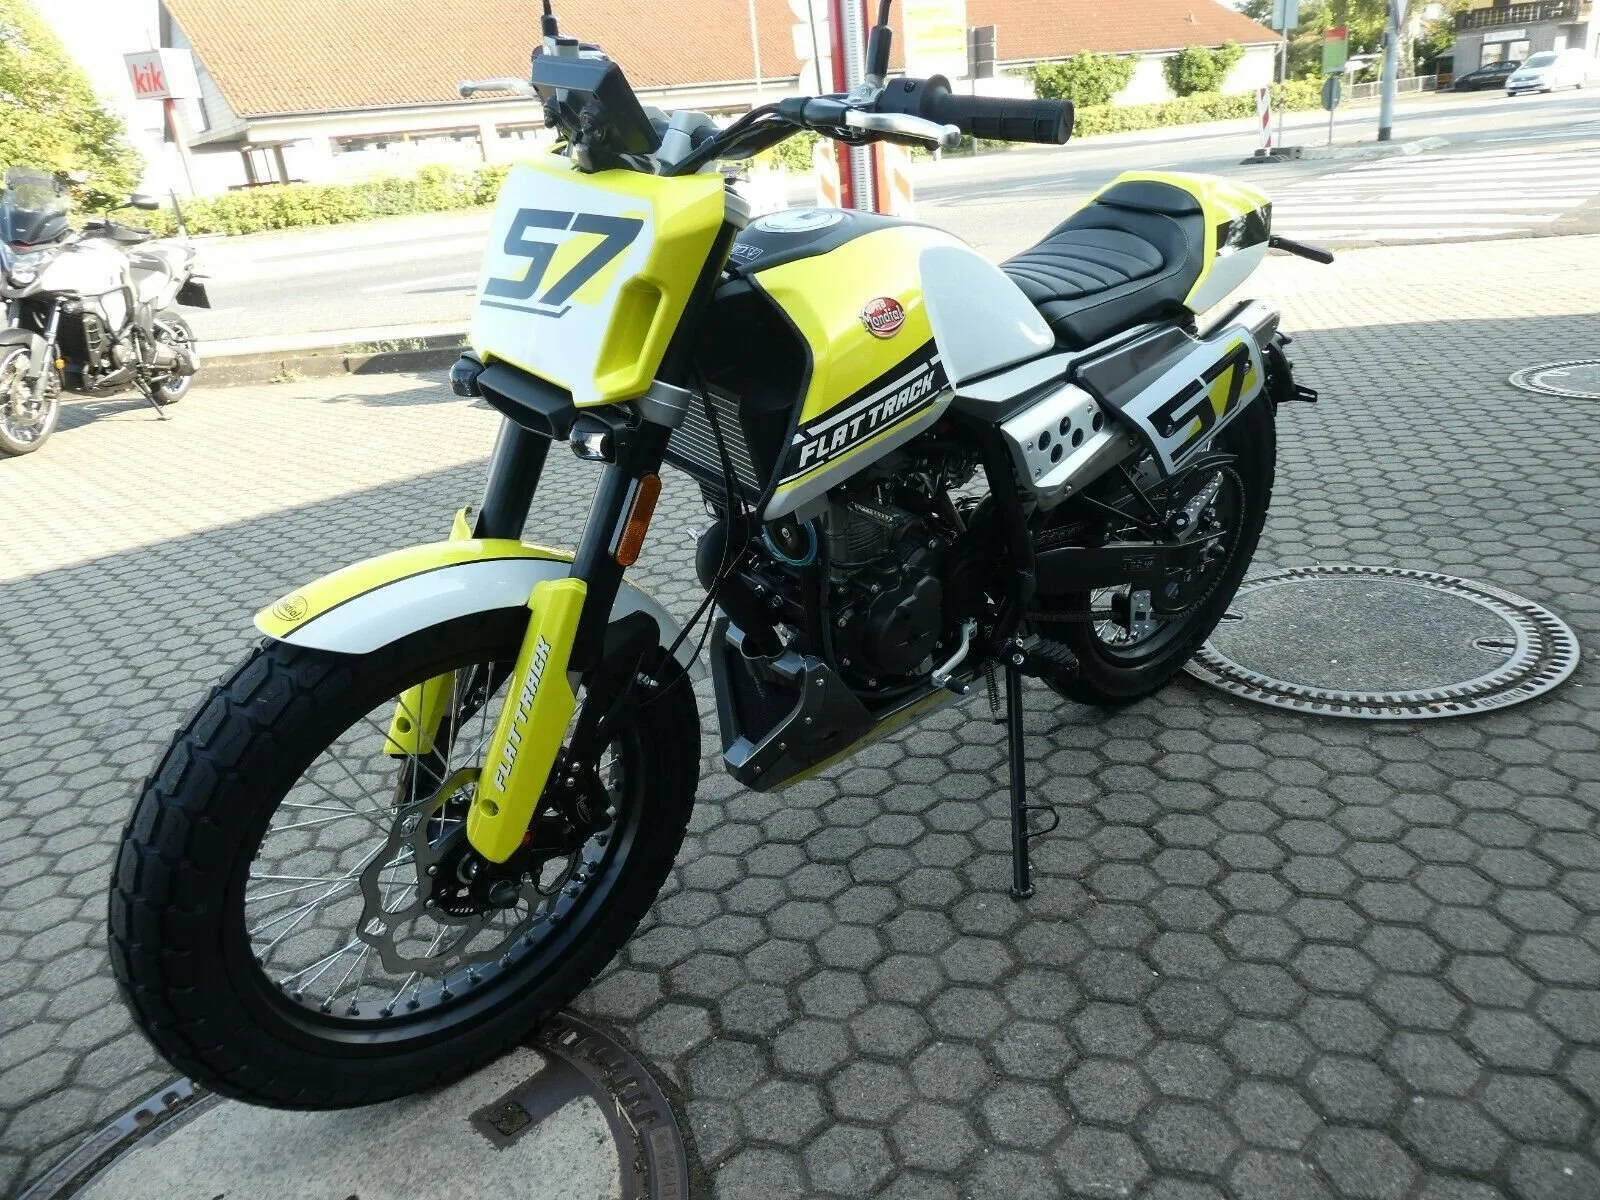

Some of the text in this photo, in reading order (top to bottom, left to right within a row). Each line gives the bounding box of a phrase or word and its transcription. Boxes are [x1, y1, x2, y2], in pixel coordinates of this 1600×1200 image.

[484, 208, 644, 306] 57
[799, 370, 935, 468] FLAT TRACK
[1147, 342, 1250, 463] 57
[493, 635, 552, 792] FLAT TRACK
